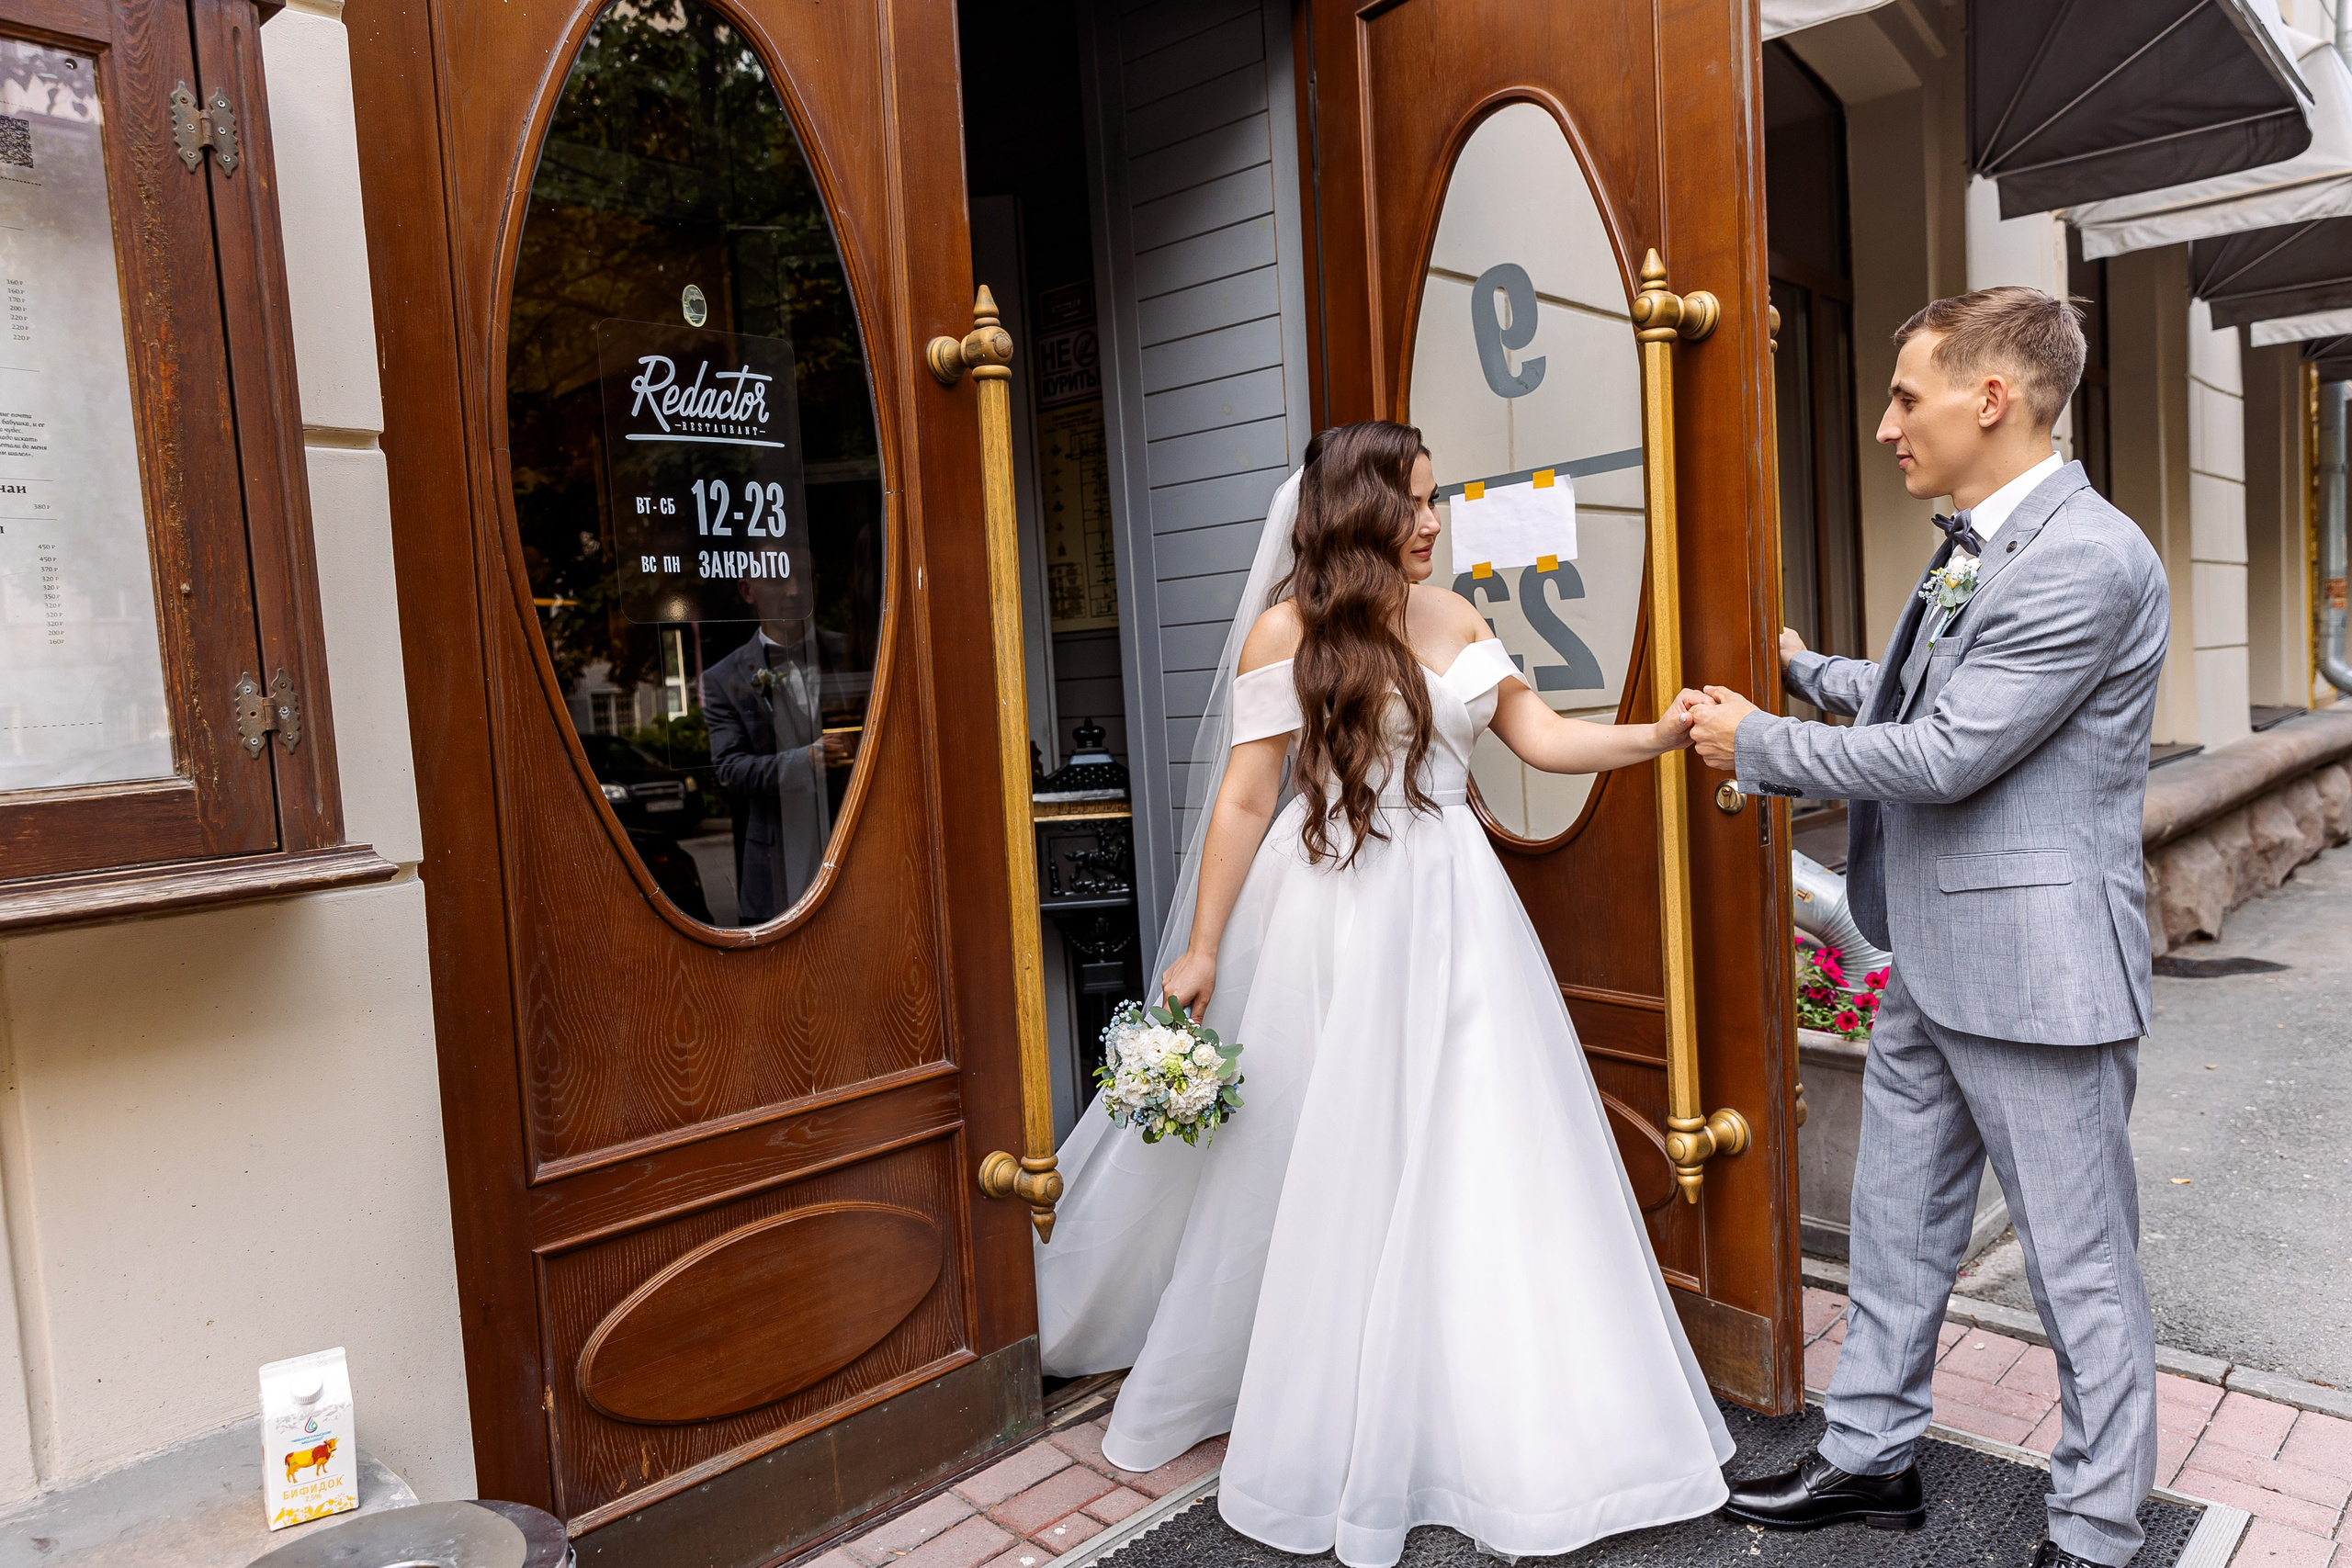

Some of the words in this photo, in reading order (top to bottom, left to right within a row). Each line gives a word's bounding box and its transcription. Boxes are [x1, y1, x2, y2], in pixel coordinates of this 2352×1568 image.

[1041, 338, 1071, 372] НЕ
[631, 355, 773, 433] Redactor
[691, 479, 787, 538] 12-23
[641, 556, 658, 573] ВС
[663, 556, 681, 573] ПН
[698, 550, 790, 579] ЗАКРЫТО
